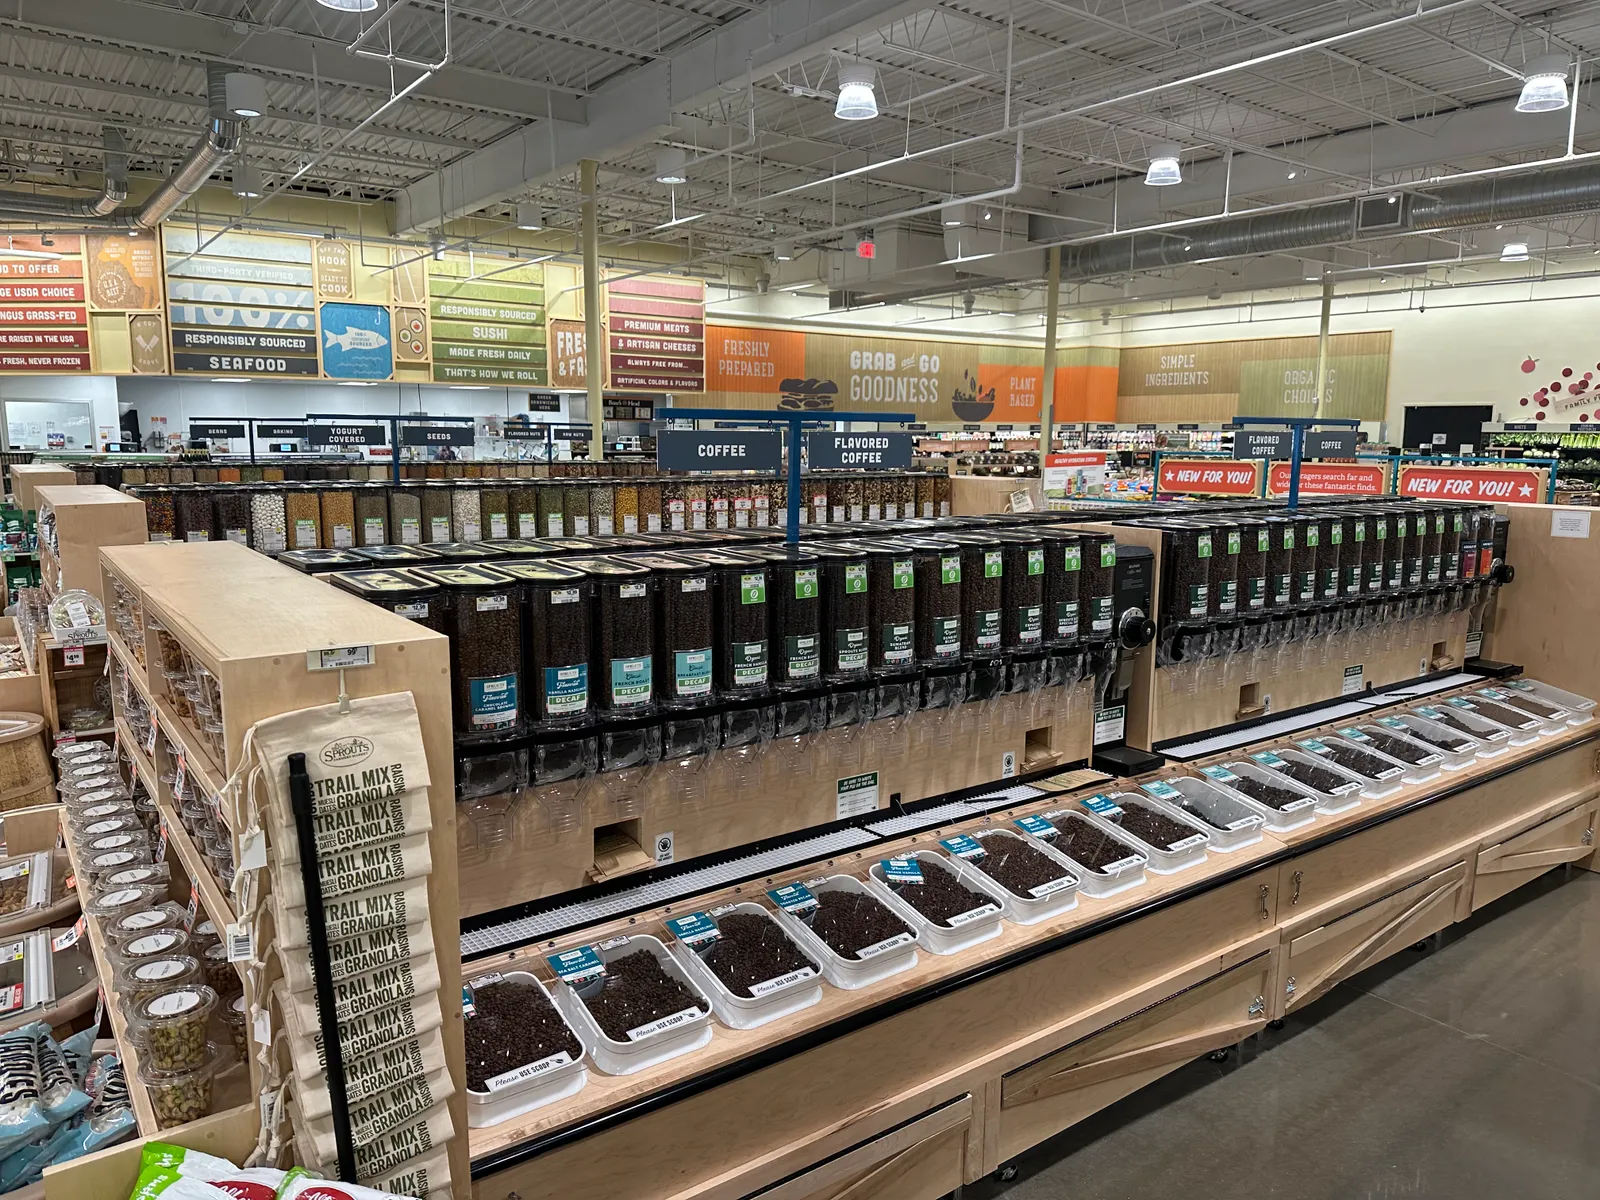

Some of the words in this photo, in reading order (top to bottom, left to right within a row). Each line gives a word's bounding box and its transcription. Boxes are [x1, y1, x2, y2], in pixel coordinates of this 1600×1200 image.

[319, 255, 346, 265] HOOK
[12, 265, 26, 273] TO
[29, 265, 60, 273] OFFER
[191, 265, 252, 277] THIRD-PARTY
[255, 270, 293, 280] VERIFIED
[320, 274, 339, 282] READY
[14, 288, 39, 297] USDA
[42, 288, 74, 297] CHOICE
[321, 284, 348, 293] COOK
[176, 283, 309, 328] 100%
[441, 305, 497, 317] RESPONSIBLY
[500, 309, 536, 320] SOURCED
[26, 311, 77, 320] GRASS-FED
[473, 327, 508, 339] SUSHI
[624, 320, 661, 331] PREMIUM
[664, 323, 690, 333] MEATS
[8, 335, 33, 343] RAISED
[35, 335, 42, 343] IN
[44, 335, 58, 343] THE
[60, 335, 74, 343] USA
[185, 334, 256, 346] RESPONSIBLY
[260, 337, 306, 348] SOURCED
[618, 339, 624, 347] &
[627, 340, 660, 350] ARTISAN
[663, 342, 696, 352] CHEESES
[449, 347, 475, 357] MADE
[477, 349, 505, 358] FRESH
[508, 351, 531, 360] DAILY
[724, 339, 770, 357] FRESHLY
[3, 358, 27, 366] FRESH,
[209, 356, 286, 371] SEAFOOD
[559, 361, 566, 376] &
[719, 359, 774, 377] PREPARED
[850, 350, 896, 371] GRAB
[901, 353, 915, 368] and
[919, 354, 940, 373] GO
[1160, 354, 1195, 369] SIMPLE
[445, 368, 476, 377] THAT'S
[480, 370, 499, 378] HOW
[501, 371, 515, 379] WE
[517, 372, 538, 380] ROLL
[617, 377, 647, 385] ARTIFICIAL
[648, 378, 668, 386] COLORS
[1145, 371, 1209, 387] INGREDIENTS
[1284, 369, 1336, 385] ORGAIC
[850, 374, 939, 403] GOODNESS
[1009, 377, 1036, 391] PLANT
[1009, 394, 1035, 407] BASED
[1565, 398, 1590, 410] FAMILY
[834, 437, 889, 449] FLAVORED
[1248, 435, 1280, 445] FLAVORED
[1321, 440, 1342, 450] COFFEE
[698, 444, 746, 457] COFFEE
[841, 452, 882, 464] COFFEE
[1252, 446, 1275, 455] COFFEE
[1176, 470, 1201, 483] NEW
[1202, 471, 1223, 484] FOR
[1226, 471, 1253, 485] YOU!
[1304, 481, 1324, 489] these
[1324, 482, 1355, 490] fantastic
[1356, 483, 1376, 491] finds.
[1407, 477, 1441, 493] NEW
[1443, 479, 1474, 495] FOR
[1476, 480, 1514, 497] YOU!
[68, 629, 98, 639] SPROUTS
[684, 678, 706, 686] DECAF
[621, 687, 645, 695] DECAF
[556, 695, 580, 703] DECAF
[324, 744, 369, 763] SPROUTS
[314, 773, 360, 798] TRAIL
[362, 766, 391, 788] MIX
[317, 798, 336, 807] MUESLI
[337, 784, 394, 810] GRANOLA
[314, 808, 360, 834] TRAIL
[362, 801, 390, 824] MIX
[319, 804, 337, 816] DATES
[390, 798, 405, 832] RAISINS
[318, 834, 336, 843] MUESLI
[337, 820, 394, 847] GRANOLA
[319, 839, 337, 850] DATES
[317, 854, 360, 879] TRAIL
[362, 846, 391, 868] MIX
[390, 843, 405, 880] RAISINS
[338, 865, 394, 890] GRANOLA
[365, 894, 394, 914] MIX
[394, 891, 406, 928] RAISINS
[340, 912, 395, 936] GRANOLA
[398, 925, 410, 958] RAISINS
[863, 948, 879, 958] Please
[879, 943, 888, 951] USE
[887, 939, 899, 948] SCOOP
[345, 946, 400, 974] GRANOLA
[580, 960, 599, 968] CARAMEL
[373, 966, 401, 990] MIX
[756, 984, 776, 994] Please
[775, 979, 785, 988] USE
[783, 973, 799, 984] SCOOP
[350, 984, 404, 1014] GRANOLA
[374, 1006, 402, 1028] MIX
[635, 1027, 657, 1039] Please
[656, 1021, 667, 1029] USE
[666, 1015, 684, 1027] SCOOP
[495, 1075, 519, 1087] Please
[519, 1067, 531, 1077] USE
[531, 1061, 550, 1074] SCOOP
